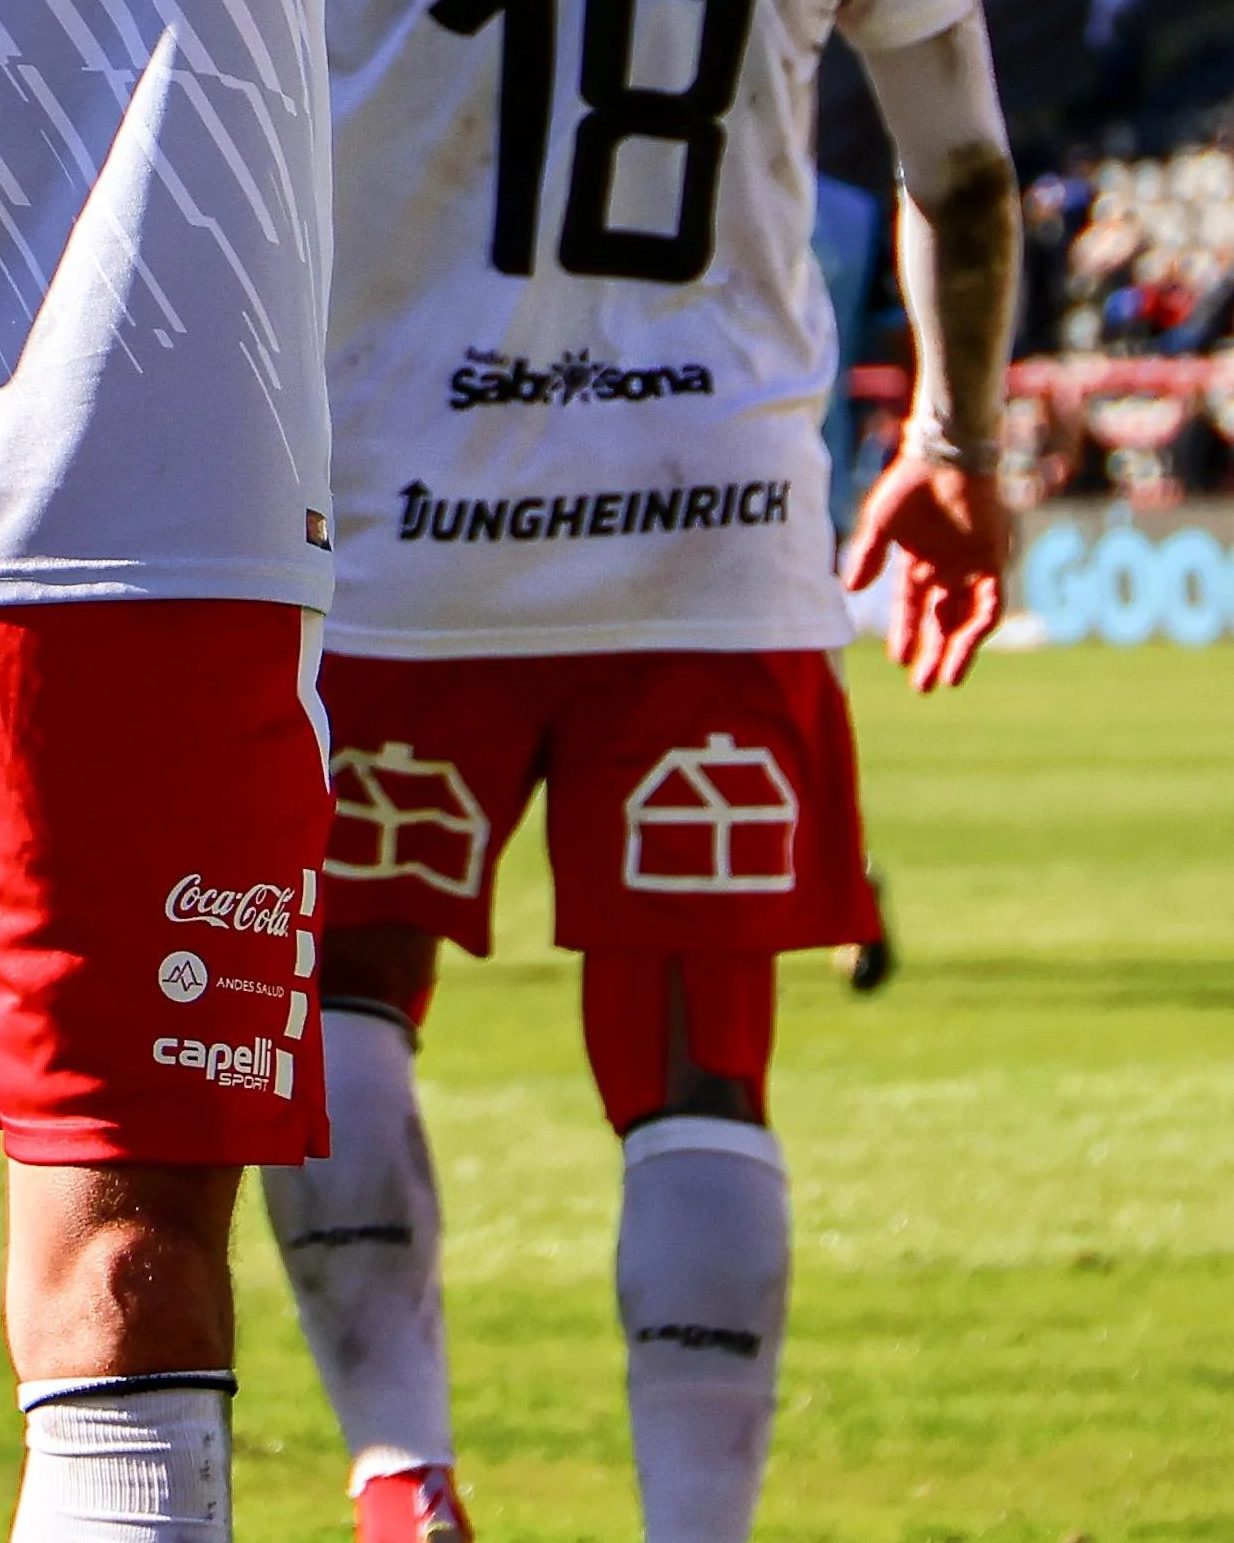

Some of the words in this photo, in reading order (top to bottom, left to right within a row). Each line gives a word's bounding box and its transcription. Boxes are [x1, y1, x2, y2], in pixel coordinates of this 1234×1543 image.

[399, 480, 791, 542] JUNGHEINRICH
[165, 874, 294, 937] Coca-Cola
[216, 977, 255, 994] ANDES
[256, 982, 285, 998] SALUD
[153, 1036, 272, 1080] capelli
[218, 1072, 270, 1092] SPORT
